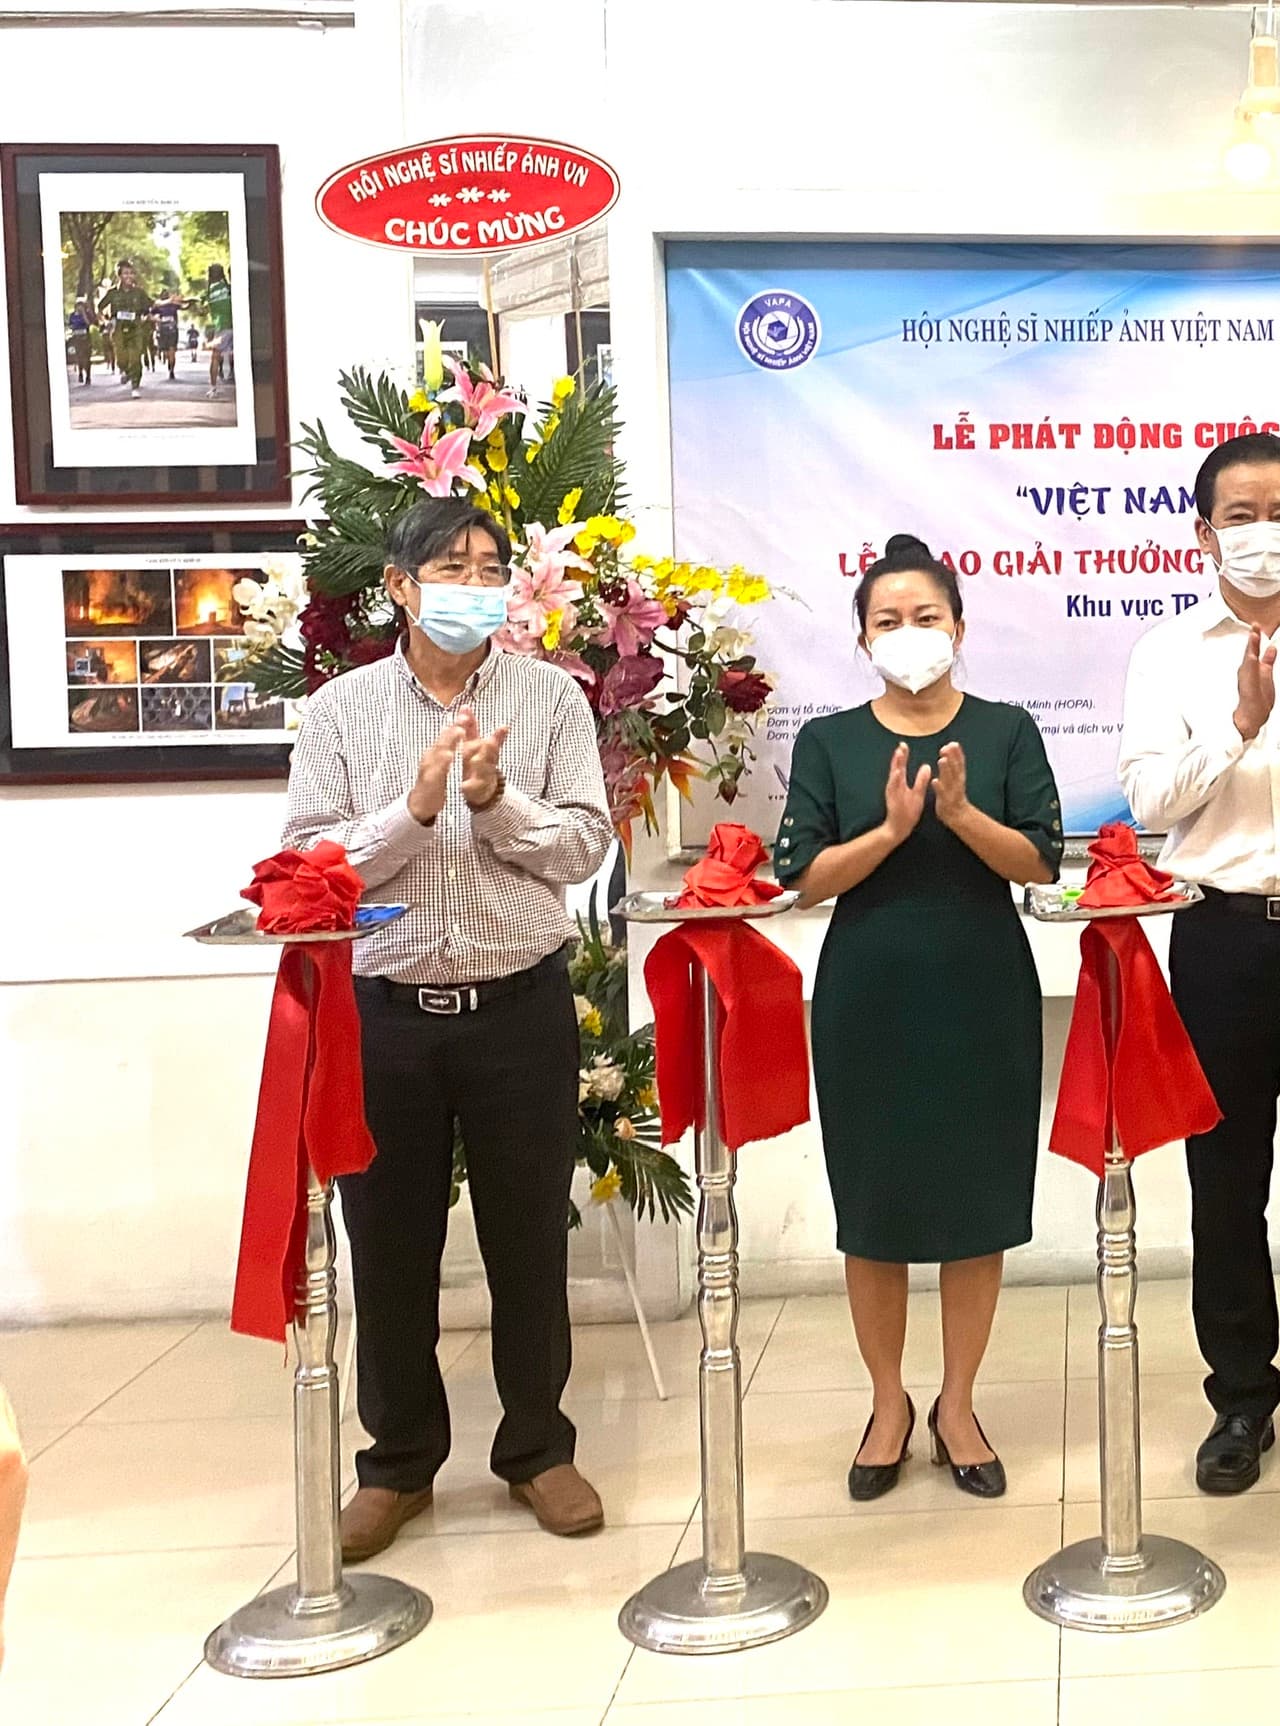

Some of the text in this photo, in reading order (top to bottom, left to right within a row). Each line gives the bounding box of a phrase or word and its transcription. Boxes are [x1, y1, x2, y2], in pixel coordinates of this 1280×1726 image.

[348, 143, 589, 202] HỘI NGHỆ SĨ NHIẾP ẢNH VN
[384, 206, 566, 246] CHÚC MỪNG
[902, 311, 942, 349] HỘI
[949, 312, 1011, 349] NGHỆ
[1017, 313, 1038, 342] SĨ
[1045, 309, 1113, 342] NHIẾP
[1119, 309, 1165, 342] ẢNH
[1171, 311, 1221, 348] VIỆT
[1227, 319, 1274, 342] NAM
[933, 412, 975, 450] LỄ
[989, 416, 1081, 450] PHÁT
[1093, 416, 1182, 455] ĐỘNG
[1124, 486, 1197, 514] NAM
[993, 540, 1063, 577] GIẢI
[1074, 538, 1204, 576] THƯỞNG
[1067, 595, 1111, 617] Khu
[1122, 600, 1164, 620] vực
[1027, 700, 1051, 710] Minh
[1054, 699, 1095, 711] (HOPA).
[767, 717, 788, 727] Đơn
[767, 731, 788, 740] Đơn
[1041, 724, 1060, 735] mại
[1077, 723, 1098, 735] dịch
[1101, 725, 1113, 735] vụ
